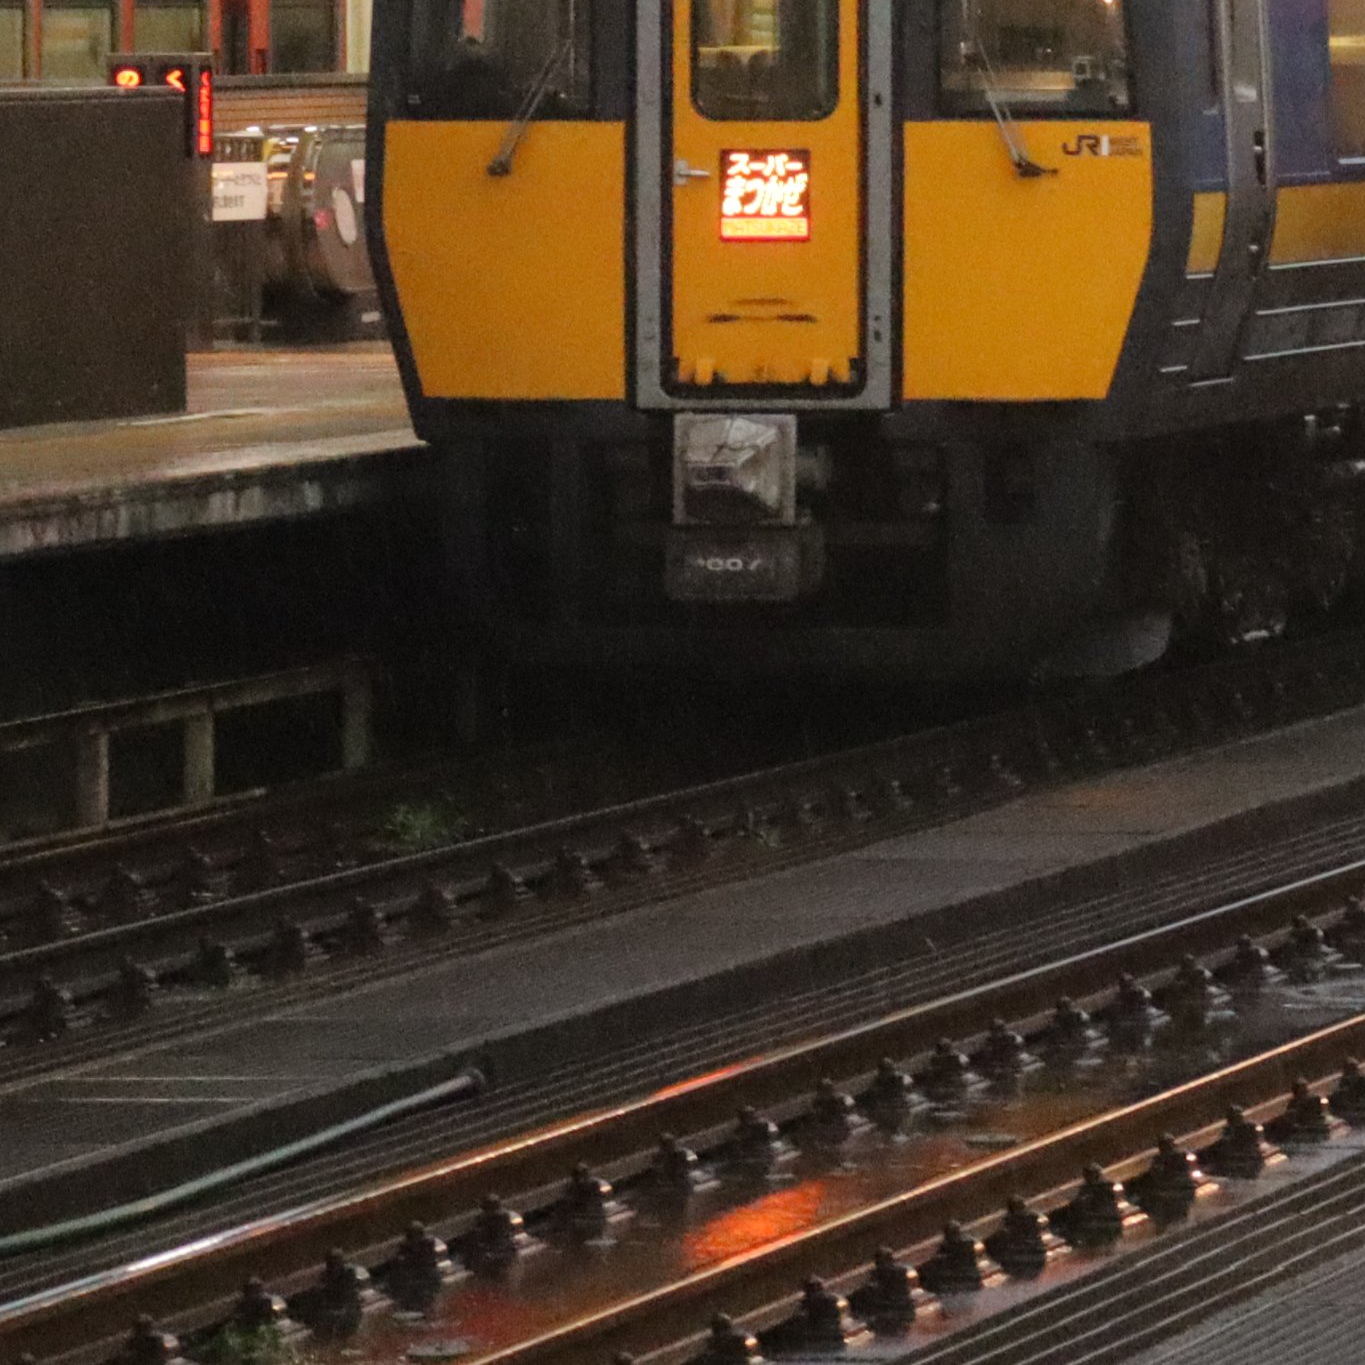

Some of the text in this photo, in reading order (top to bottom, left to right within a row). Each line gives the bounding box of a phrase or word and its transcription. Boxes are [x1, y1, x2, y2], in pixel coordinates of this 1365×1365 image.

[1062, 134, 1099, 156] JR
[727, 153, 803, 176] スーパー
[722, 173, 808, 216] まつかぜ
